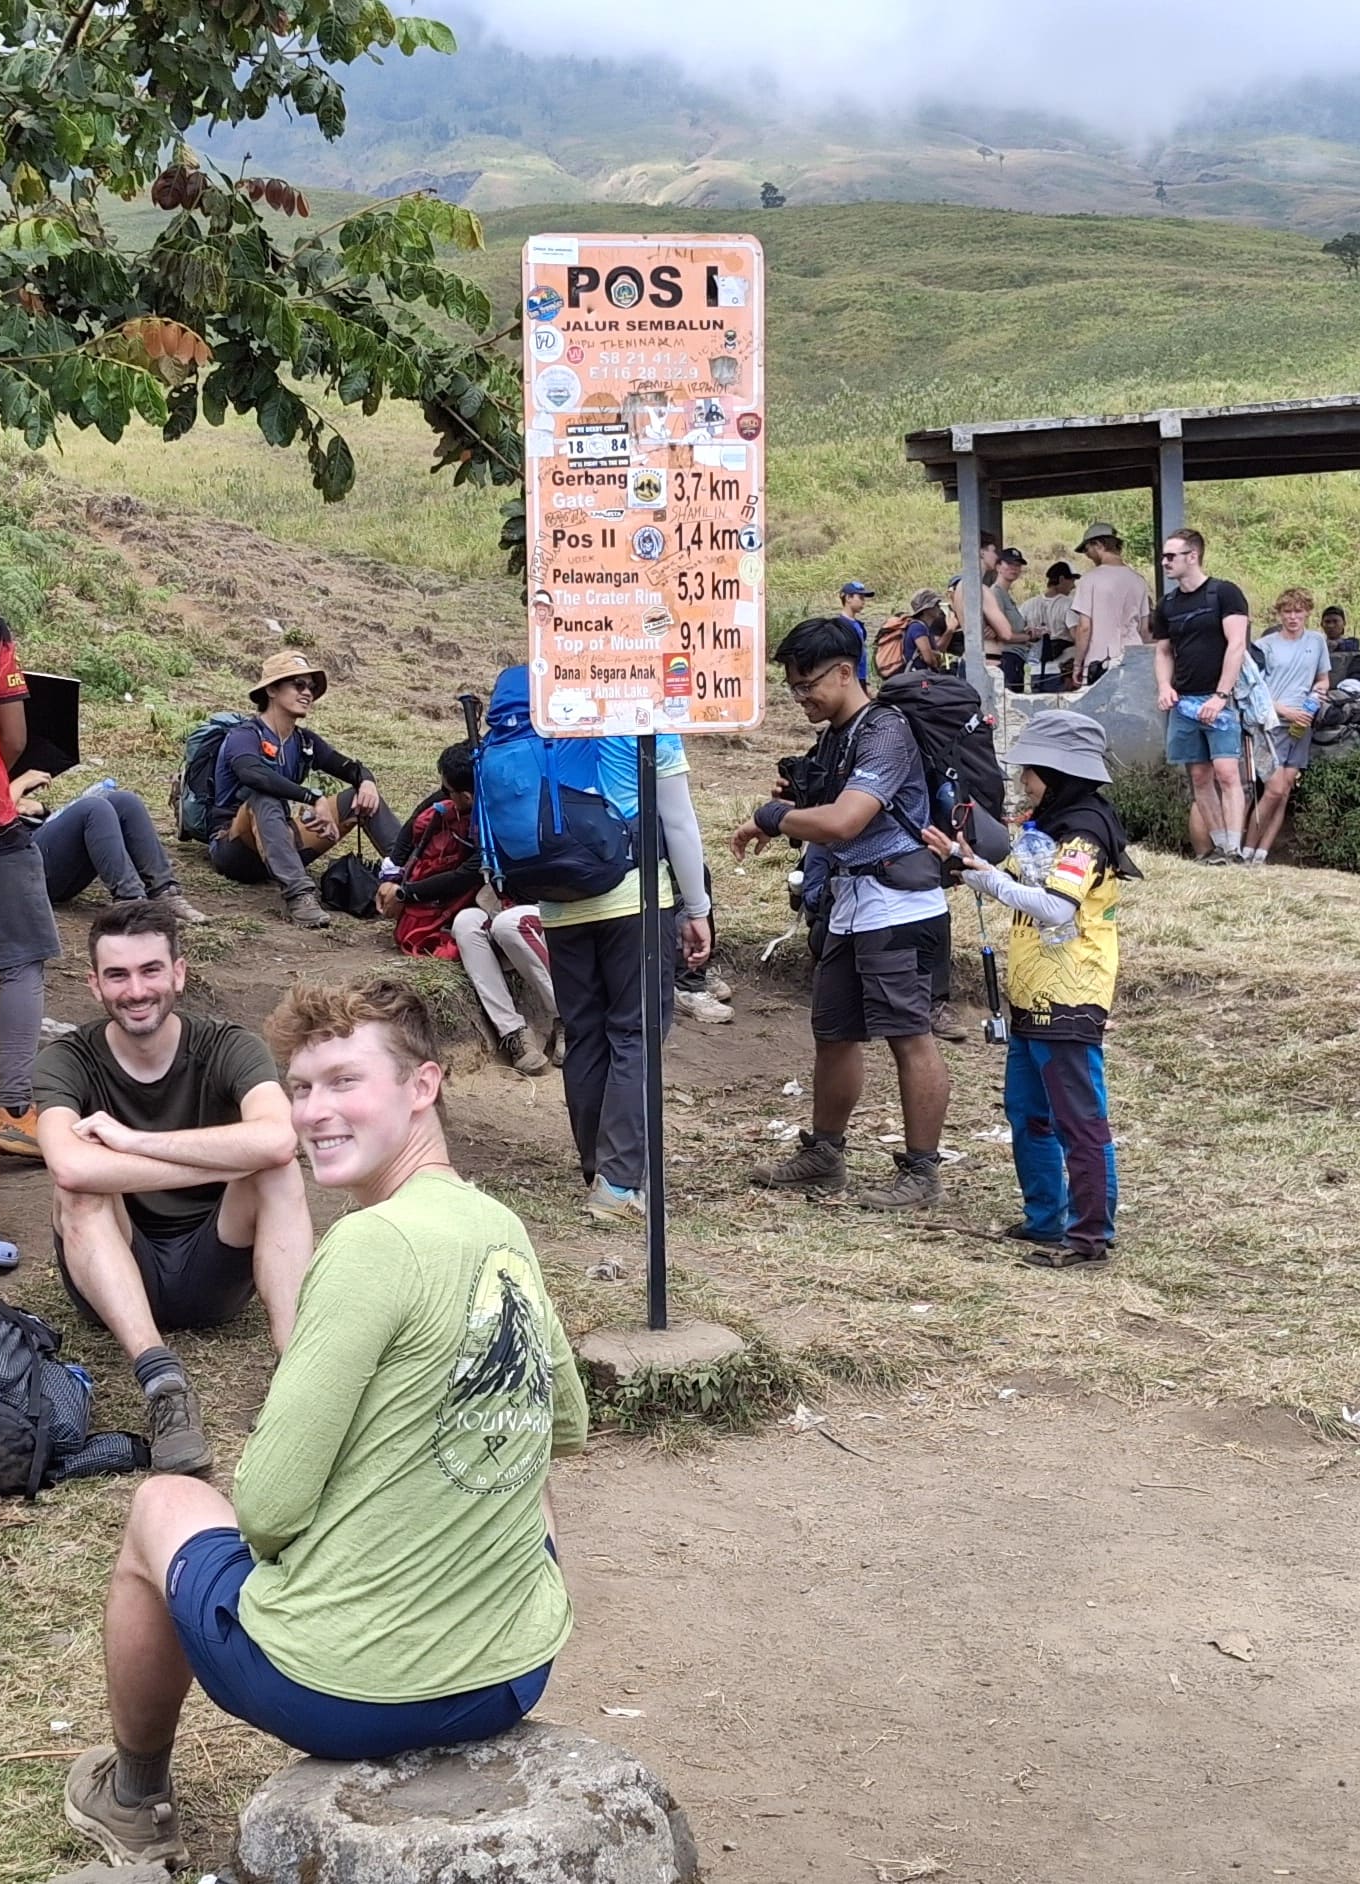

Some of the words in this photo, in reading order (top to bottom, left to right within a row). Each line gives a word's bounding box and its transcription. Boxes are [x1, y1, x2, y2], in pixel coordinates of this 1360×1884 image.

[567, 266, 683, 309] POS
[561, 320, 620, 332] JALUR
[626, 319, 724, 331] SEMBALUN
[626, 351, 645, 364] 21
[589, 366, 631, 379] E116
[637, 366, 657, 379] 28
[664, 366, 699, 379] 32.9
[568, 441, 584, 454] 18
[611, 438, 627, 452] 84
[552, 470, 628, 489] Gerbang
[674, 472, 703, 507] 3,7
[709, 471, 740, 501] km
[552, 492, 596, 508] Gate
[552, 528, 593, 548] Pos
[601, 528, 616, 548] II
[674, 521, 703, 557] 1,4
[710, 521, 740, 550] km
[552, 567, 639, 588] Pelawangan
[678, 571, 705, 606] 5,3
[711, 571, 740, 600] km
[553, 589, 581, 606] The
[585, 589, 629, 605] Crater
[634, 588, 662, 605] Rim
[553, 616, 614, 632] Puncak
[680, 621, 705, 655] 9,1
[712, 621, 741, 650] km
[554, 635, 584, 656] Top
[589, 634, 604, 651] of
[611, 635, 660, 651] Mount
[590, 664, 627, 684] Segara
[630, 664, 656, 680] Anak
[696, 671, 707, 700] 9
[713, 670, 741, 698] km
[595, 684, 621, 698] Anak
[624, 683, 649, 698] Lake
